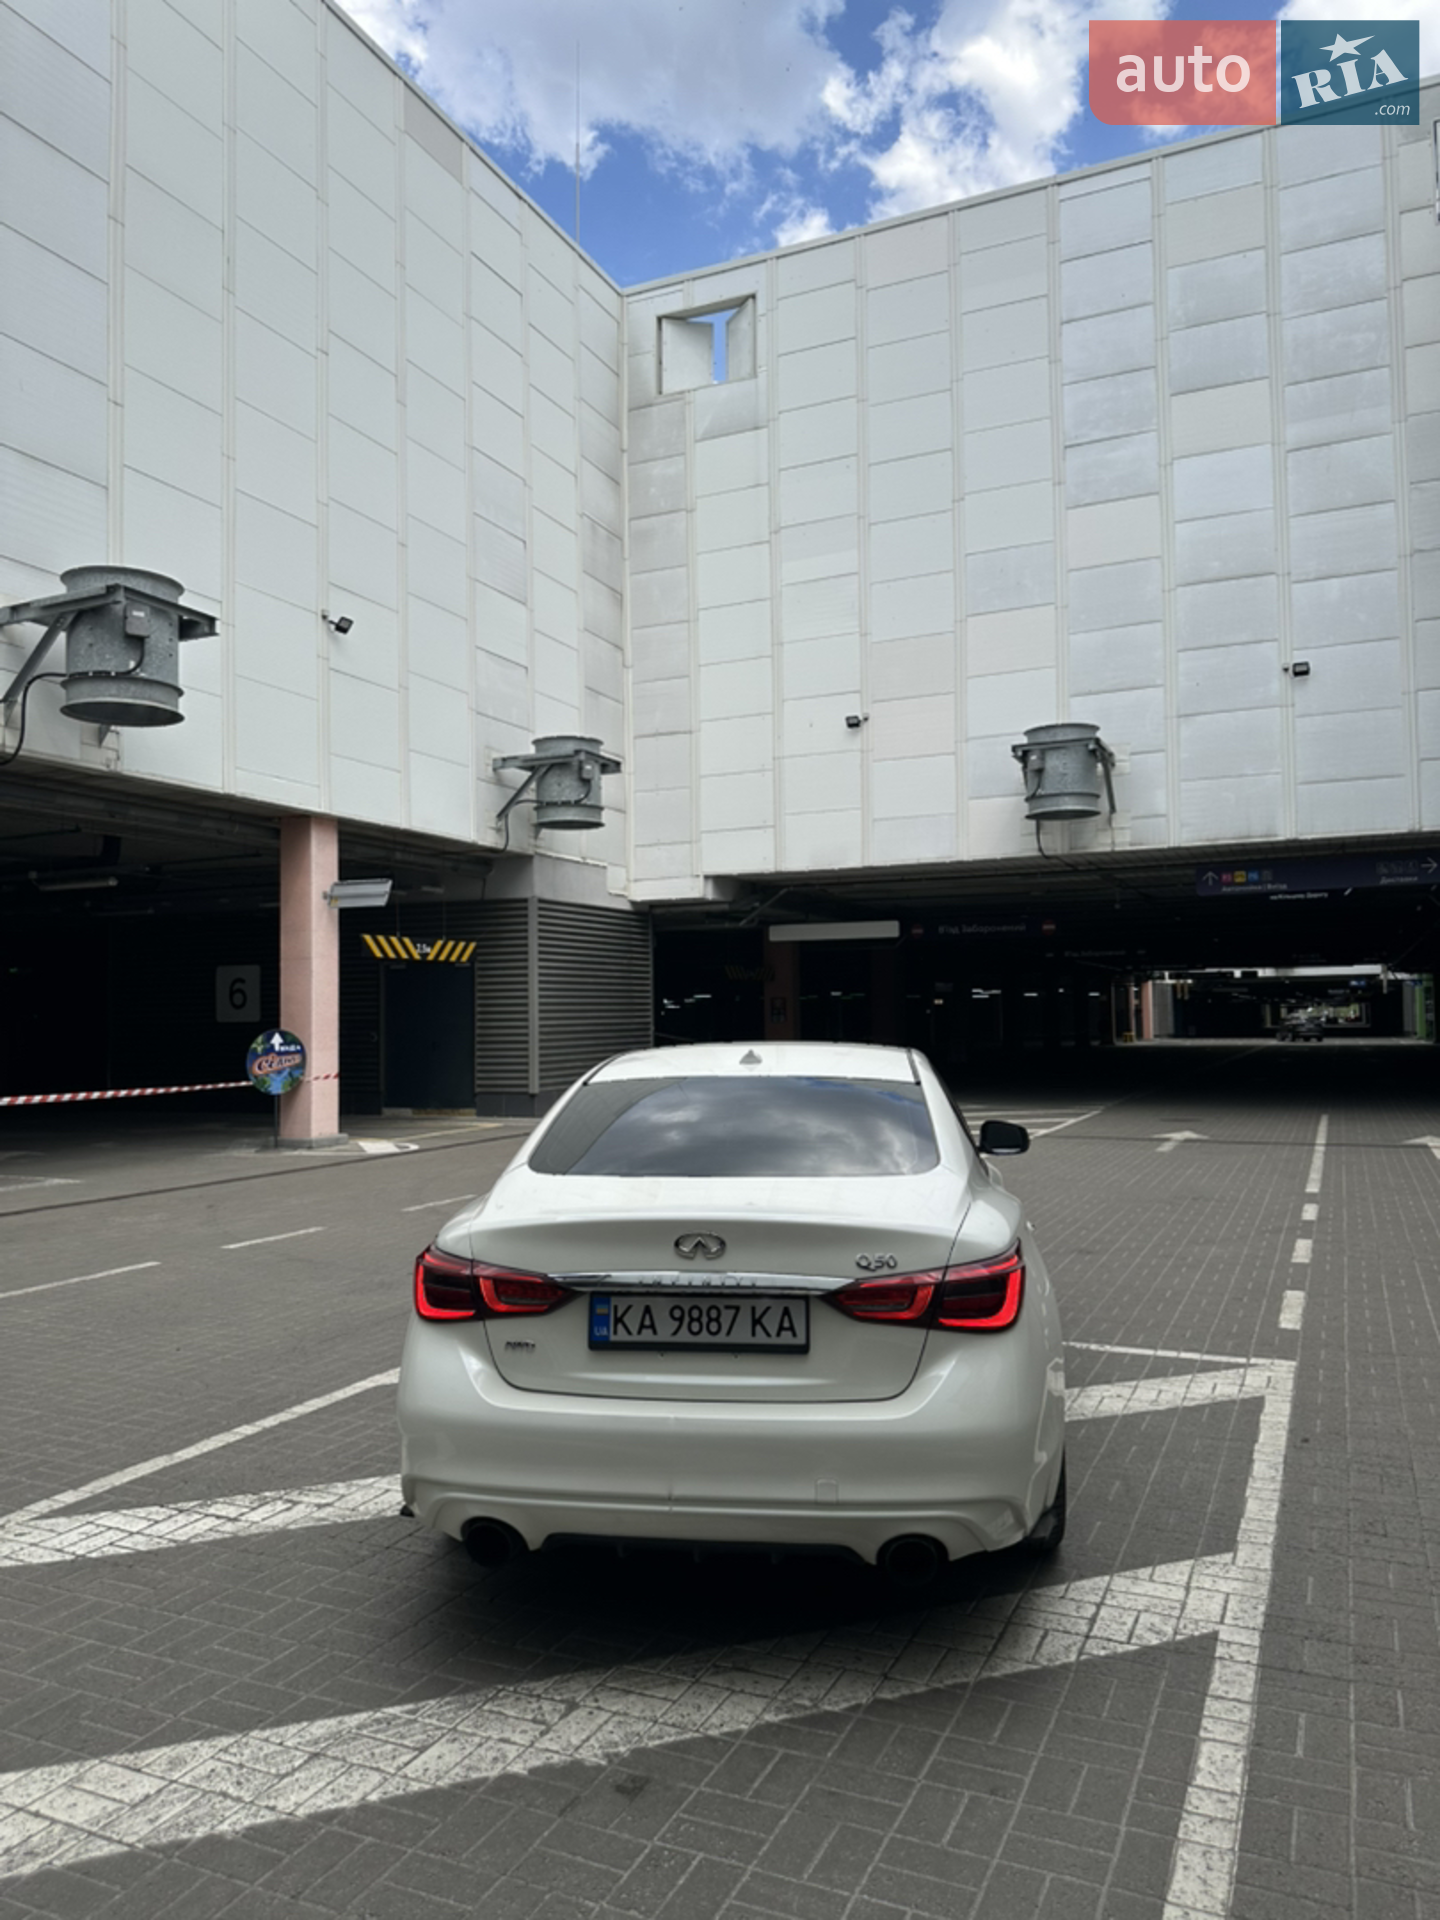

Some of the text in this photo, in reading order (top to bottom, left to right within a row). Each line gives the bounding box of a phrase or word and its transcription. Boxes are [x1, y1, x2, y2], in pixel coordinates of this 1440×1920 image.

[228, 977, 248, 1010] 6
[855, 1252, 898, 1273] Q50
[593, 1326, 609, 1336] UA
[611, 1303, 799, 1339] KA 9887 KA
